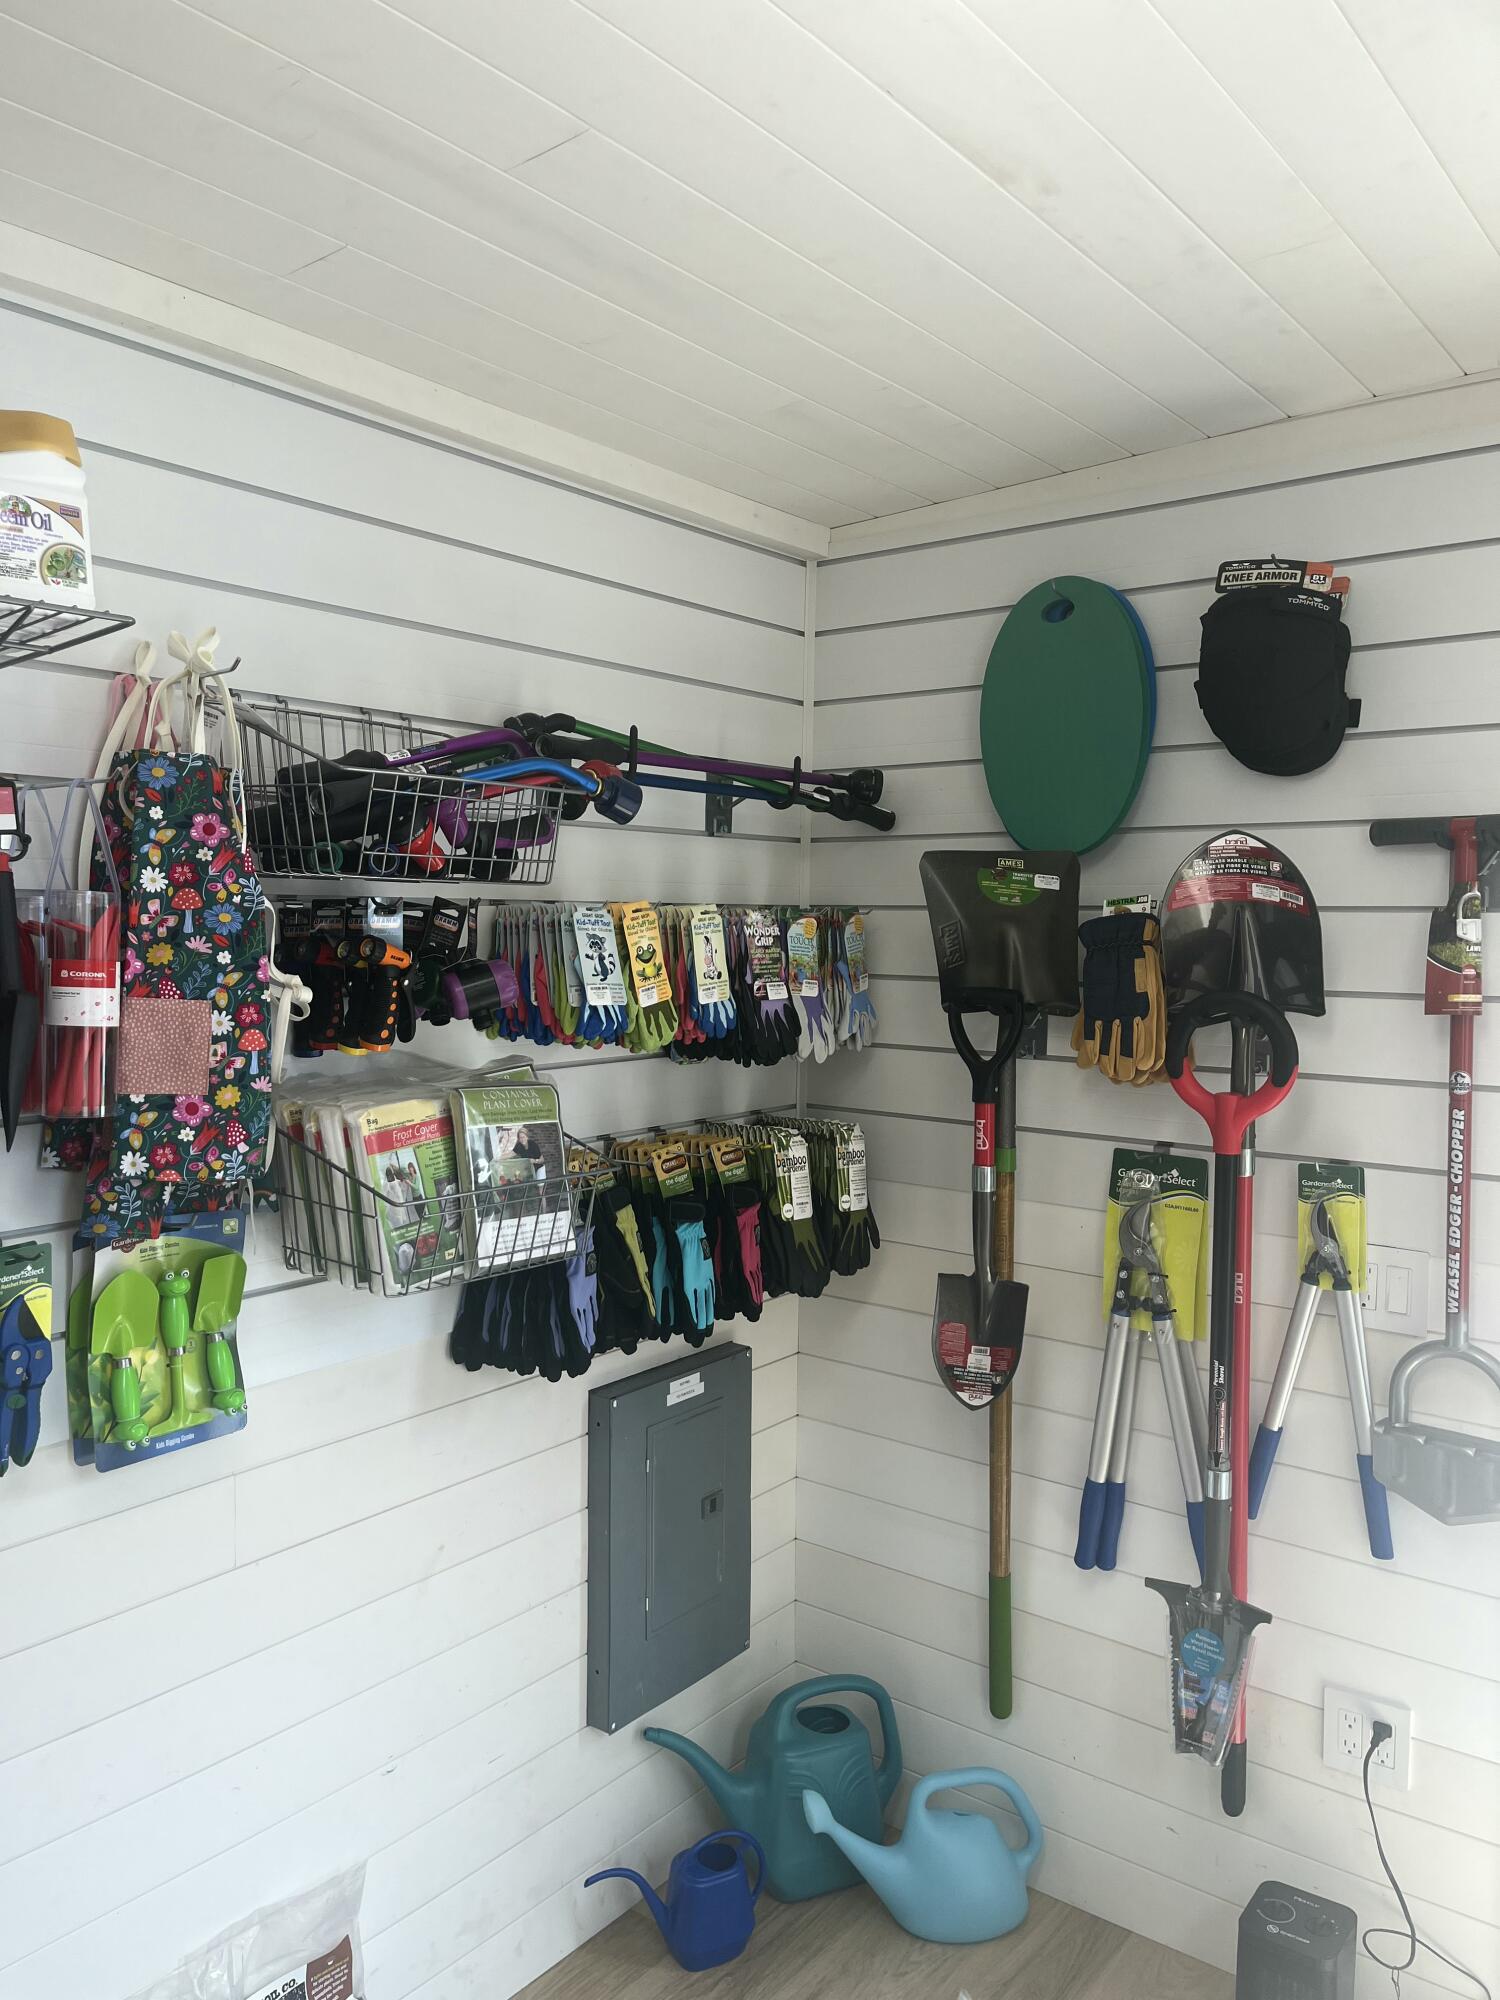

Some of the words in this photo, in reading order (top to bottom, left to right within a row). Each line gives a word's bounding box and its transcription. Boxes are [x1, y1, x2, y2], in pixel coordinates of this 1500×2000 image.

[0, 510, 29, 527] eem
[31, 511, 53, 531] Oil
[1223, 572, 1253, 583] KNEE
[1255, 571, 1298, 581] ARMOR
[1288, 597, 1331, 611] TOMMYCO
[1272, 863, 1280, 871] 5
[743, 925, 780, 936] WONDER
[755, 936, 774, 946] GRIP
[70, 970, 107, 978] CORONA
[482, 1088, 540, 1100] CONTAINER
[483, 1100, 511, 1110] PLANT
[513, 1098, 543, 1108] COVER
[392, 1129, 413, 1142] Frost
[414, 1122, 438, 1136] Cover
[976, 1119, 989, 1151] bond
[776, 1153, 807, 1168] bamboo
[837, 1149, 865, 1161] bamboo
[732, 1166, 745, 1176] digger
[674, 1173, 688, 1184] digger
[1166, 1173, 1197, 1187] Select
[24, 1267, 45, 1278] Select
[1447, 1252, 1461, 1314] WEASEL
[281, 1978, 299, 1994] CO.
